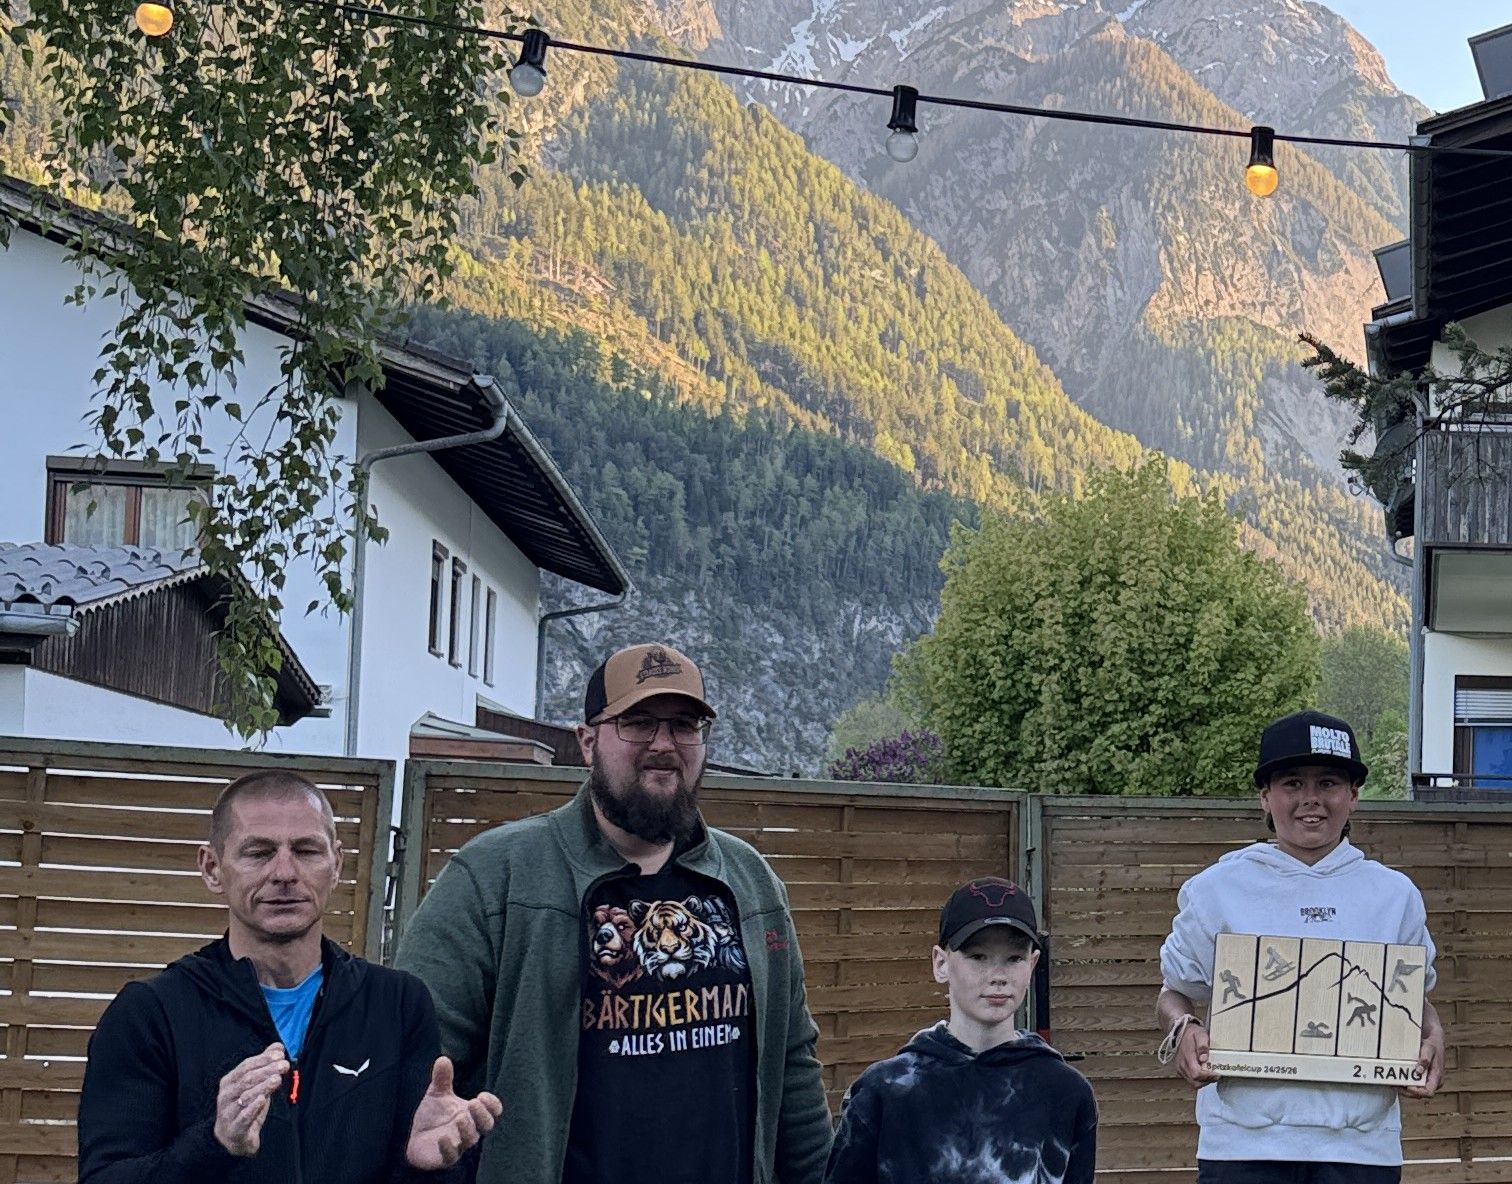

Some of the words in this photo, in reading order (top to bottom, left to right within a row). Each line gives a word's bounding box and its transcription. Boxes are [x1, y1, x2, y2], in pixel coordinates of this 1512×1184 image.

[1310, 725, 1350, 741] MOLTO
[1310, 737, 1351, 754] BRUTALE
[621, 1033, 664, 1056] ALLES
[669, 1030, 687, 1052] IN
[692, 1024, 733, 1049] EINEM
[1264, 1064, 1298, 1075] 24/25/26
[1353, 1065, 1367, 1079] 2.
[1374, 1066, 1423, 1081] RANG
